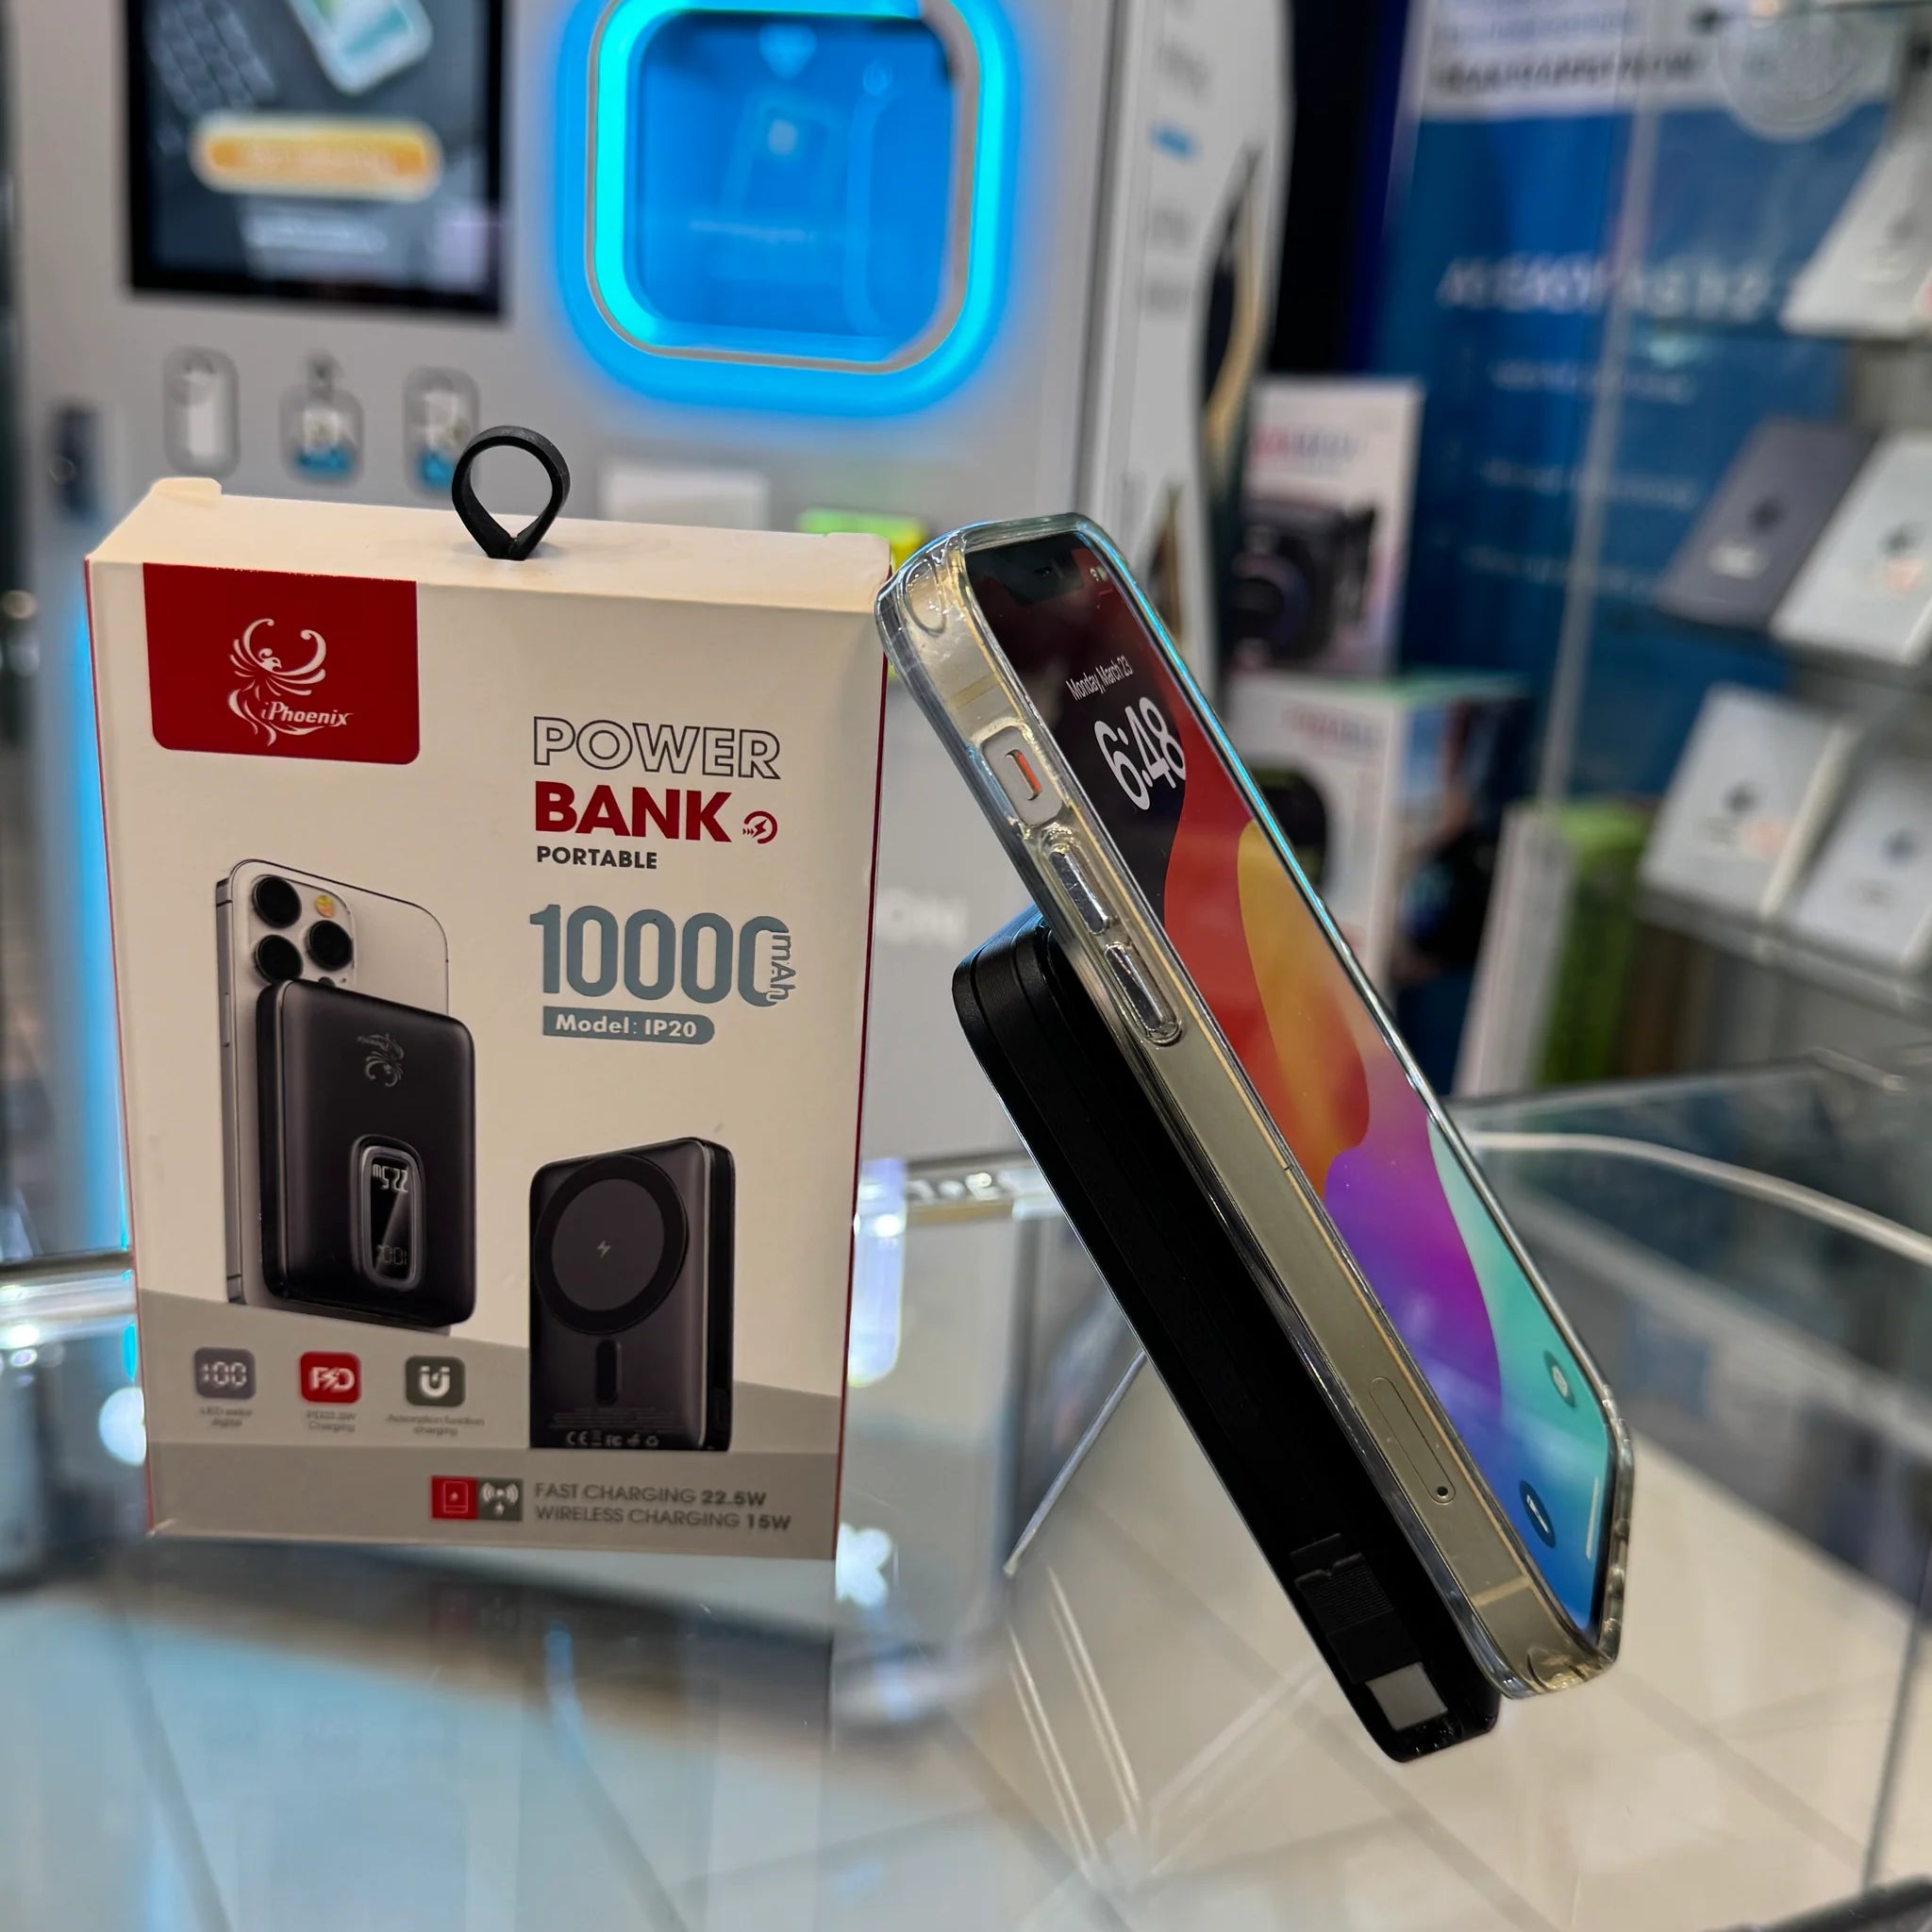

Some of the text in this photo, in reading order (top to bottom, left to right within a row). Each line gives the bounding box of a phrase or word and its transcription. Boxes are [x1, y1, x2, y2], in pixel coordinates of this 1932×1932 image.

[1095, 659, 1125, 687] March
[1116, 655, 1134, 677] 23
[260, 701, 354, 727] iPhoenix
[533, 716, 781, 780] POWER
[1094, 696, 1187, 810] 6:48
[535, 780, 733, 842] BANK
[537, 845, 658, 870] PORTABLE
[529, 904, 790, 1008] 10000
[769, 933, 797, 1001] mAh
[555, 1013, 697, 1038] Model: IP20
[201, 1361, 247, 1387] 100
[535, 1482, 767, 1507] FAST CHARGING 22.5W
[536, 1506, 791, 1530] WIRELESS CHARGING 15W
